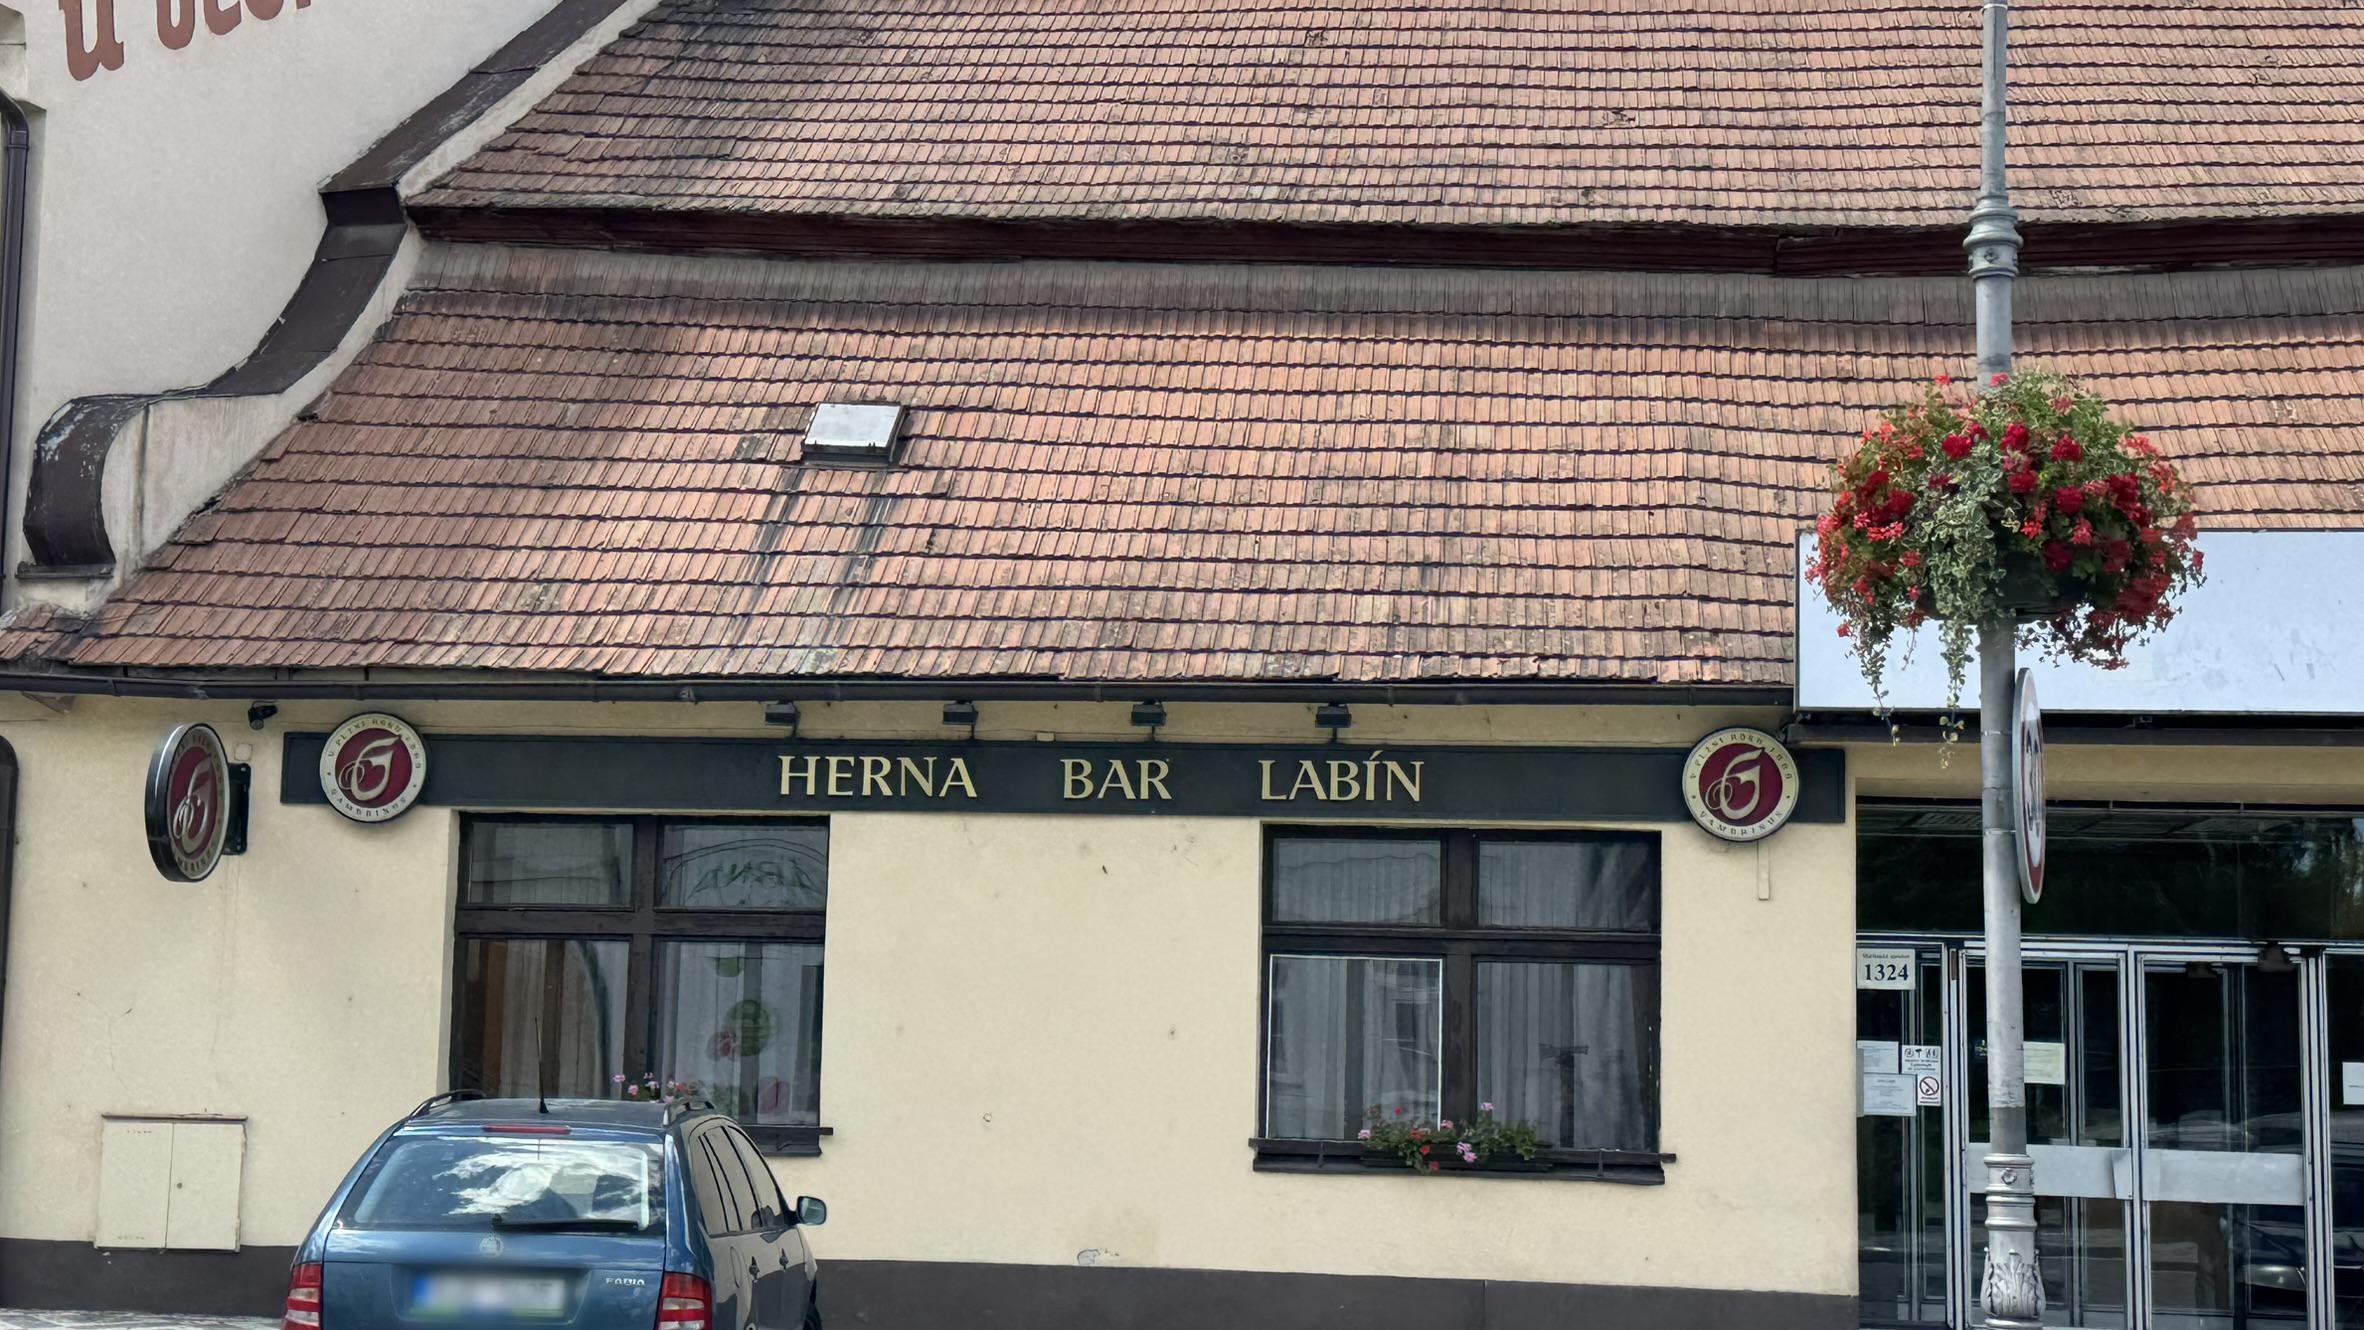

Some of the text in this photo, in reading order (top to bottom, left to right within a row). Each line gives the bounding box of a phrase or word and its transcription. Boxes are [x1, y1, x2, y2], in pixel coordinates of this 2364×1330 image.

[779, 750, 1425, 802] HERNA BAR LABÍN
[1865, 963, 1909, 981] 1324
